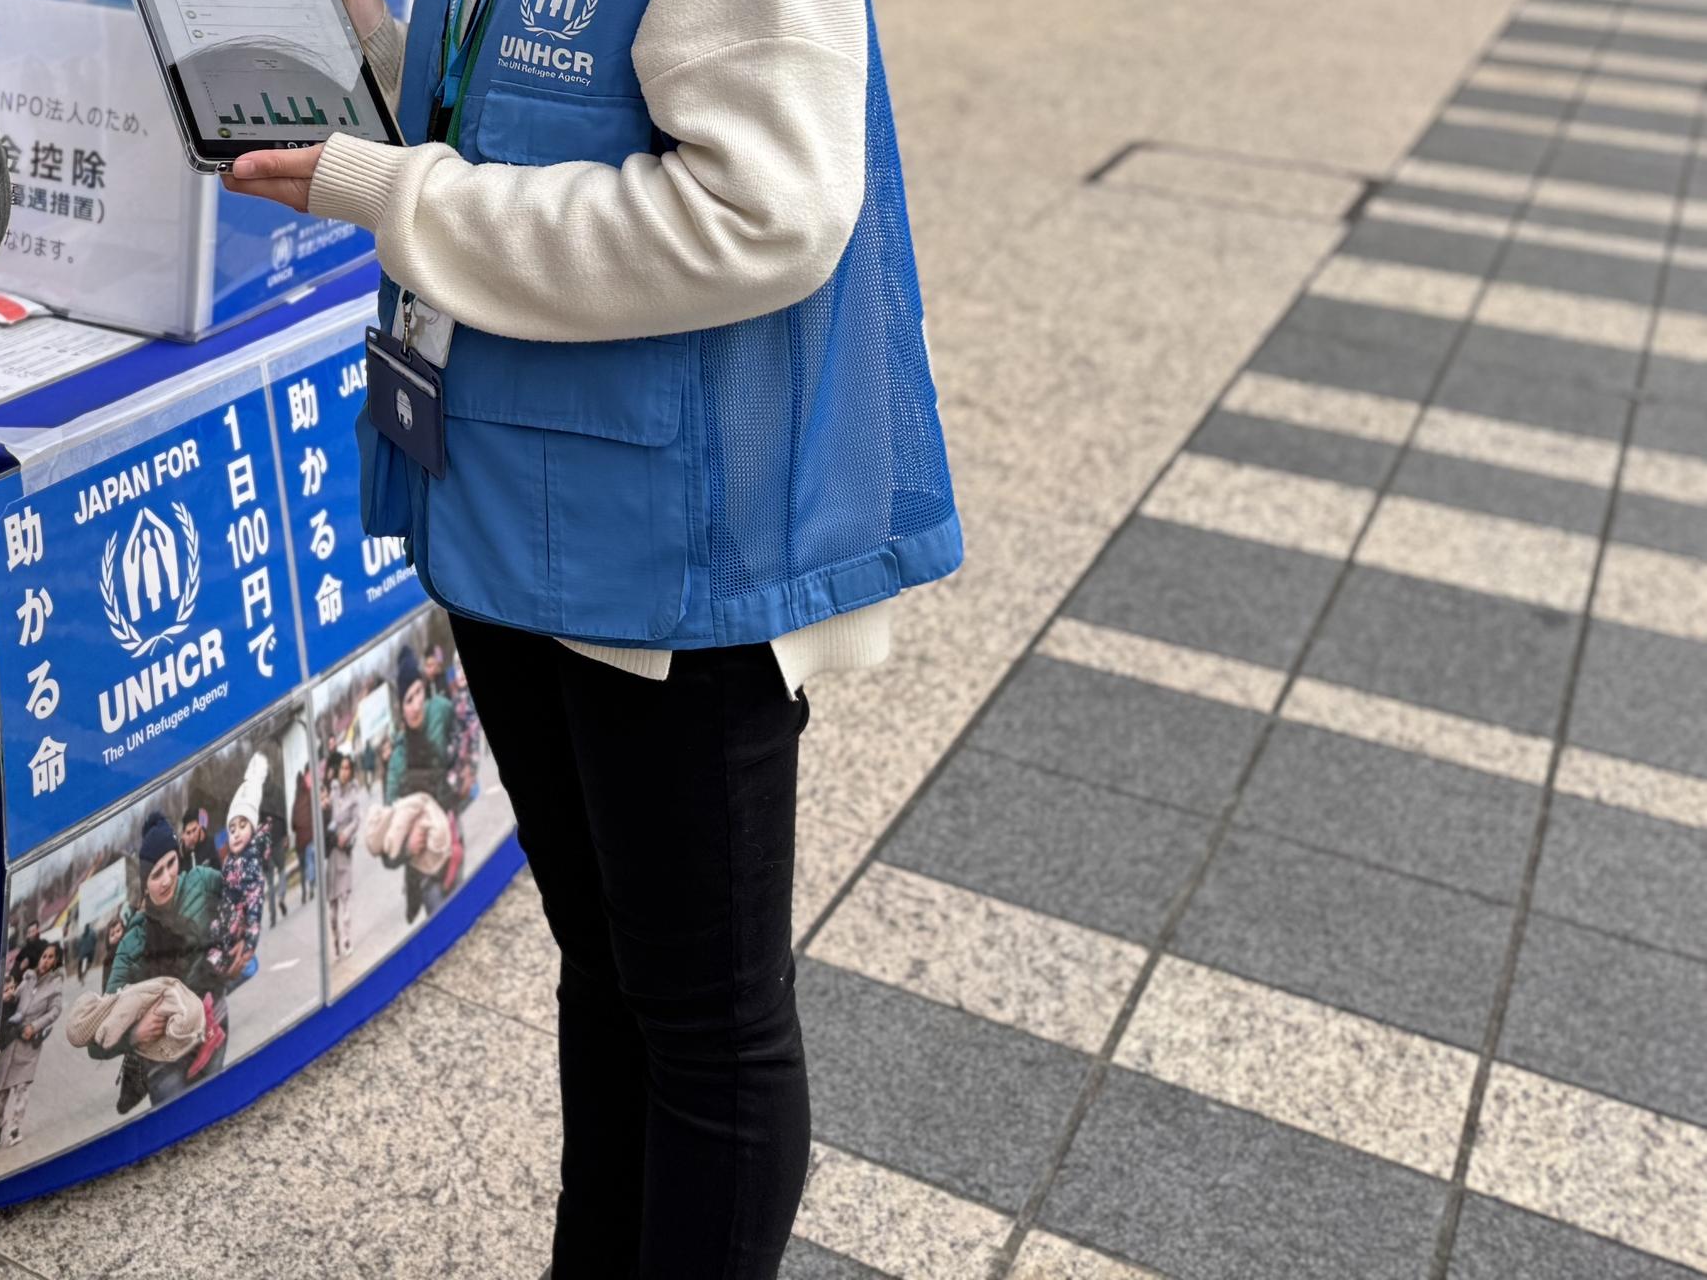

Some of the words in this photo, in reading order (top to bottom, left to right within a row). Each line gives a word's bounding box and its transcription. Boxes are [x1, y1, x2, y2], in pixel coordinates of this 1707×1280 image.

[500, 35, 594, 76] UNHCR
[508, 60, 521, 70] UN
[521, 64, 557, 78] Refugee
[557, 72, 591, 87] Agency
[74, 462, 150, 525] JAPAN
[154, 438, 201, 486] FOR
[287, 377, 343, 627] 助かる命
[223, 404, 277, 678] 1日100円で
[4, 506, 68, 797] 助かる命
[98, 628, 226, 734] UNHCR
[102, 744, 125, 765] The
[126, 729, 145, 751] UN
[146, 705, 190, 740] Refugee
[192, 681, 229, 713] Agency
